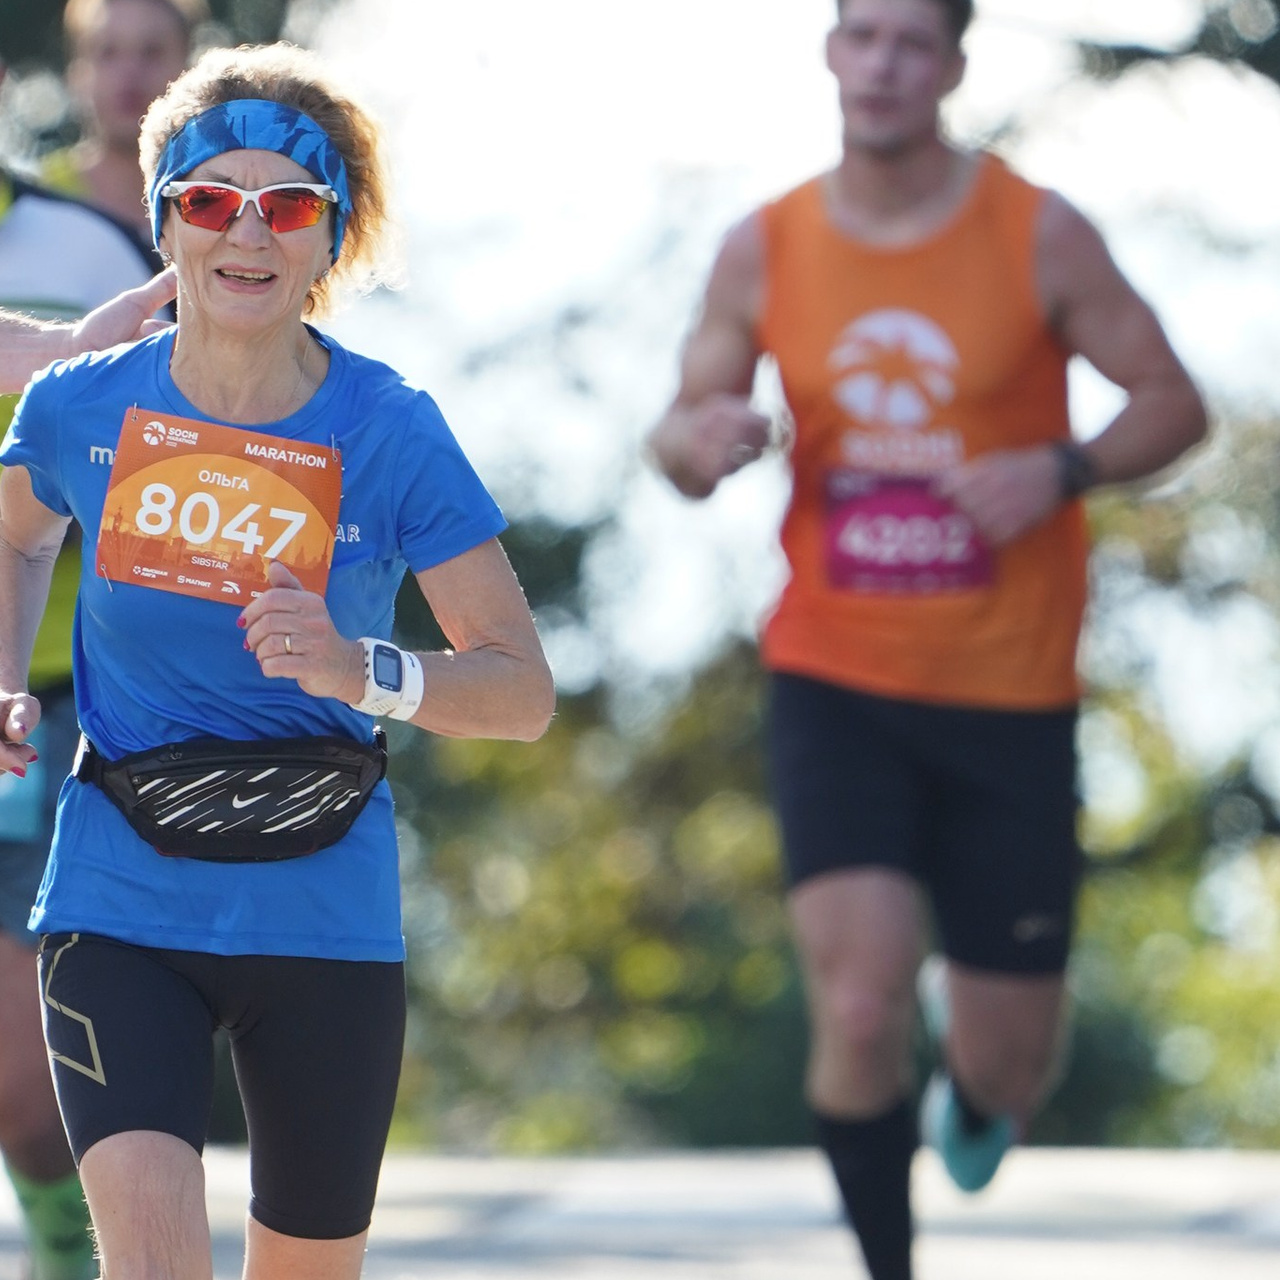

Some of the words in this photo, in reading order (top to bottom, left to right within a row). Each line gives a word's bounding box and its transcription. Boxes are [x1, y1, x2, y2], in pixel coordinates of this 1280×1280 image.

[168, 427, 199, 440] SOCHI
[244, 442, 327, 469] MARATHON
[198, 470, 250, 492] ОЛЬГА
[135, 482, 307, 560] 8047
[334, 523, 361, 543] AR
[190, 555, 229, 571] SIBSTAR
